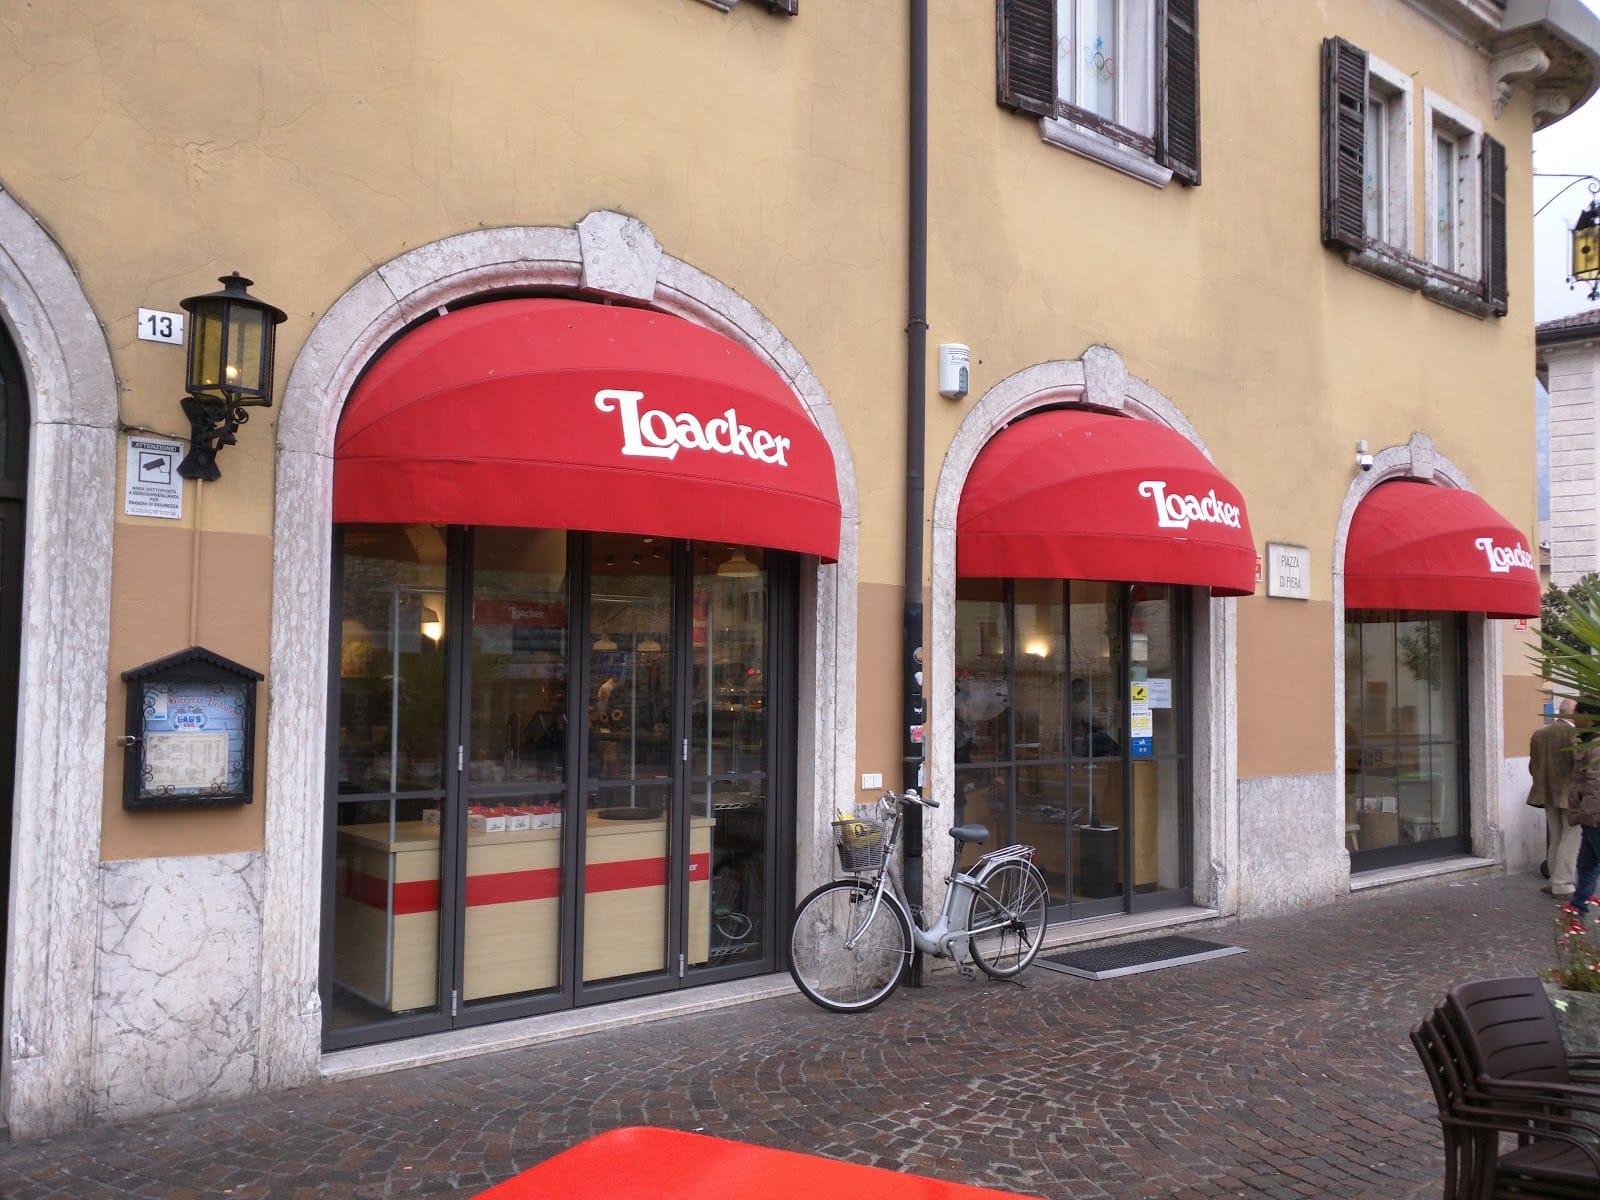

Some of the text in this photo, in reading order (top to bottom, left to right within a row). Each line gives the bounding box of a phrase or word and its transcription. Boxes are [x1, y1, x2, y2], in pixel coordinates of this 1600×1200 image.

[148, 314, 172, 338] 13
[594, 389, 791, 467] Loacker
[1138, 480, 1242, 530] Loacker
[1280, 555, 1300, 568] PIAZZA
[1286, 576, 1301, 589] FIERA
